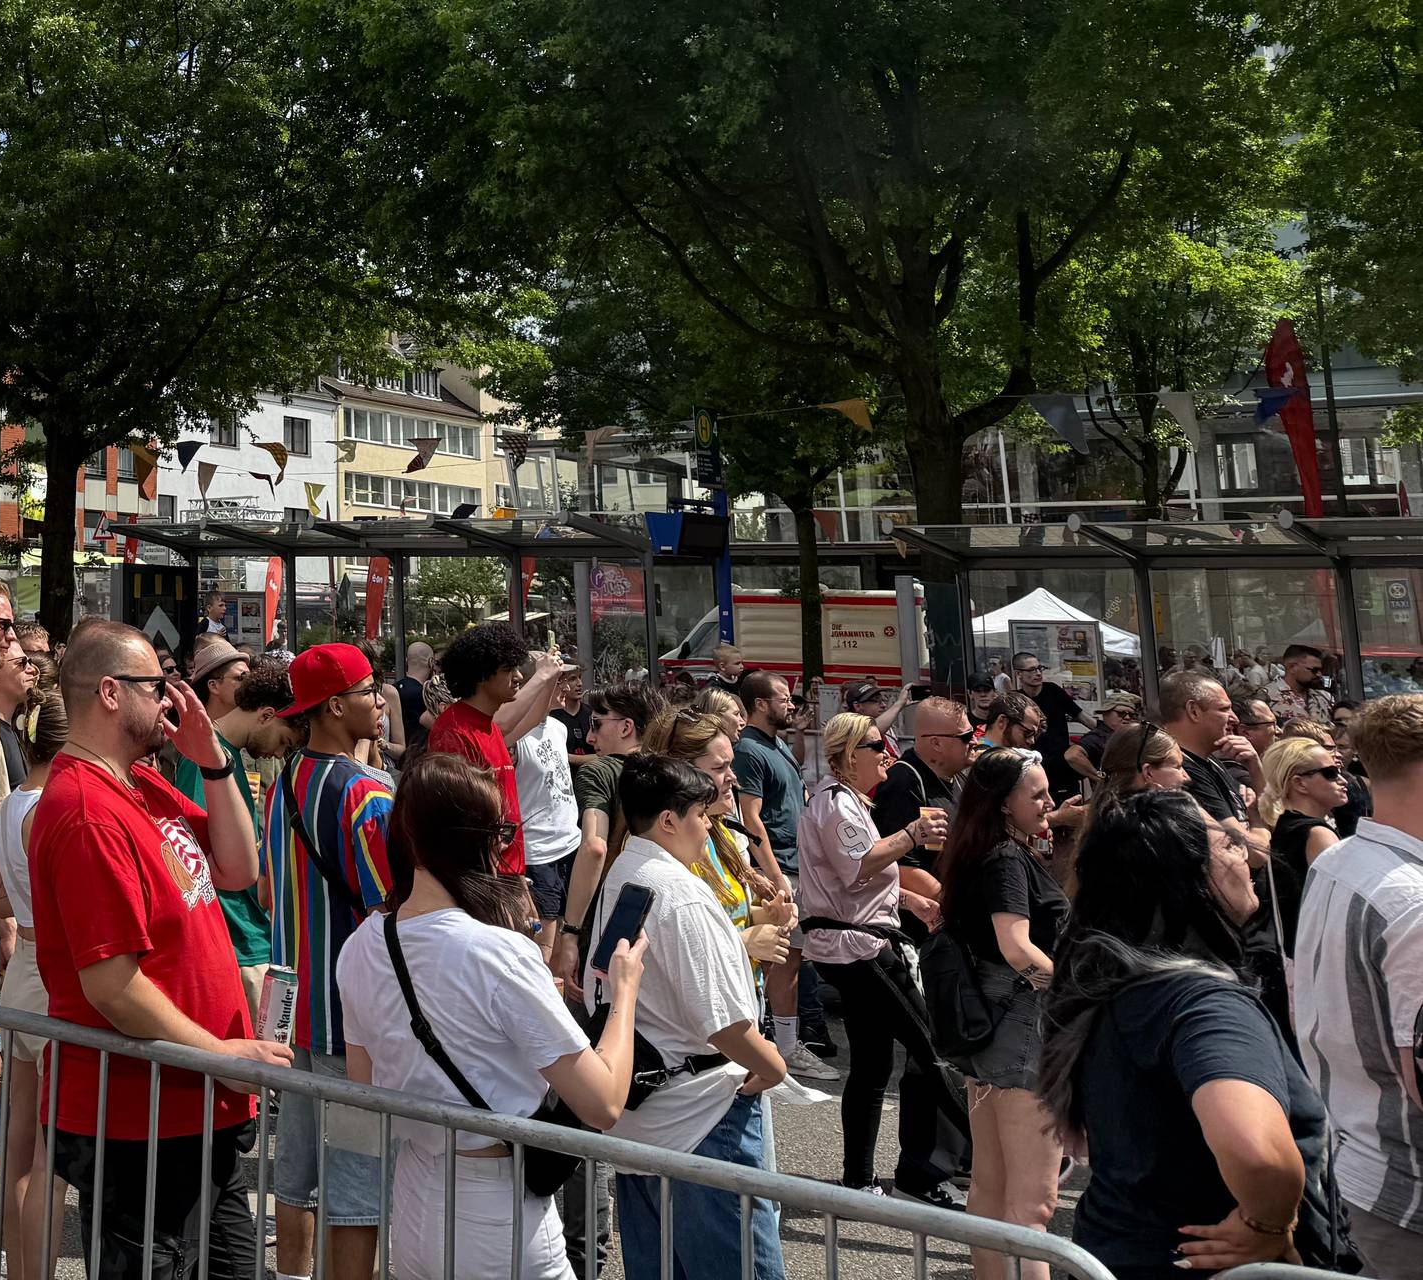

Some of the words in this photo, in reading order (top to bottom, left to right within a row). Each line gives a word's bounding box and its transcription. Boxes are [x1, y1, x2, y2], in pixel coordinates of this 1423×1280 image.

[831, 630, 875, 638] JOHANNITER
[842, 640, 858, 649] 112
[835, 820, 874, 861] 9
[277, 989, 294, 1030] Stauder
